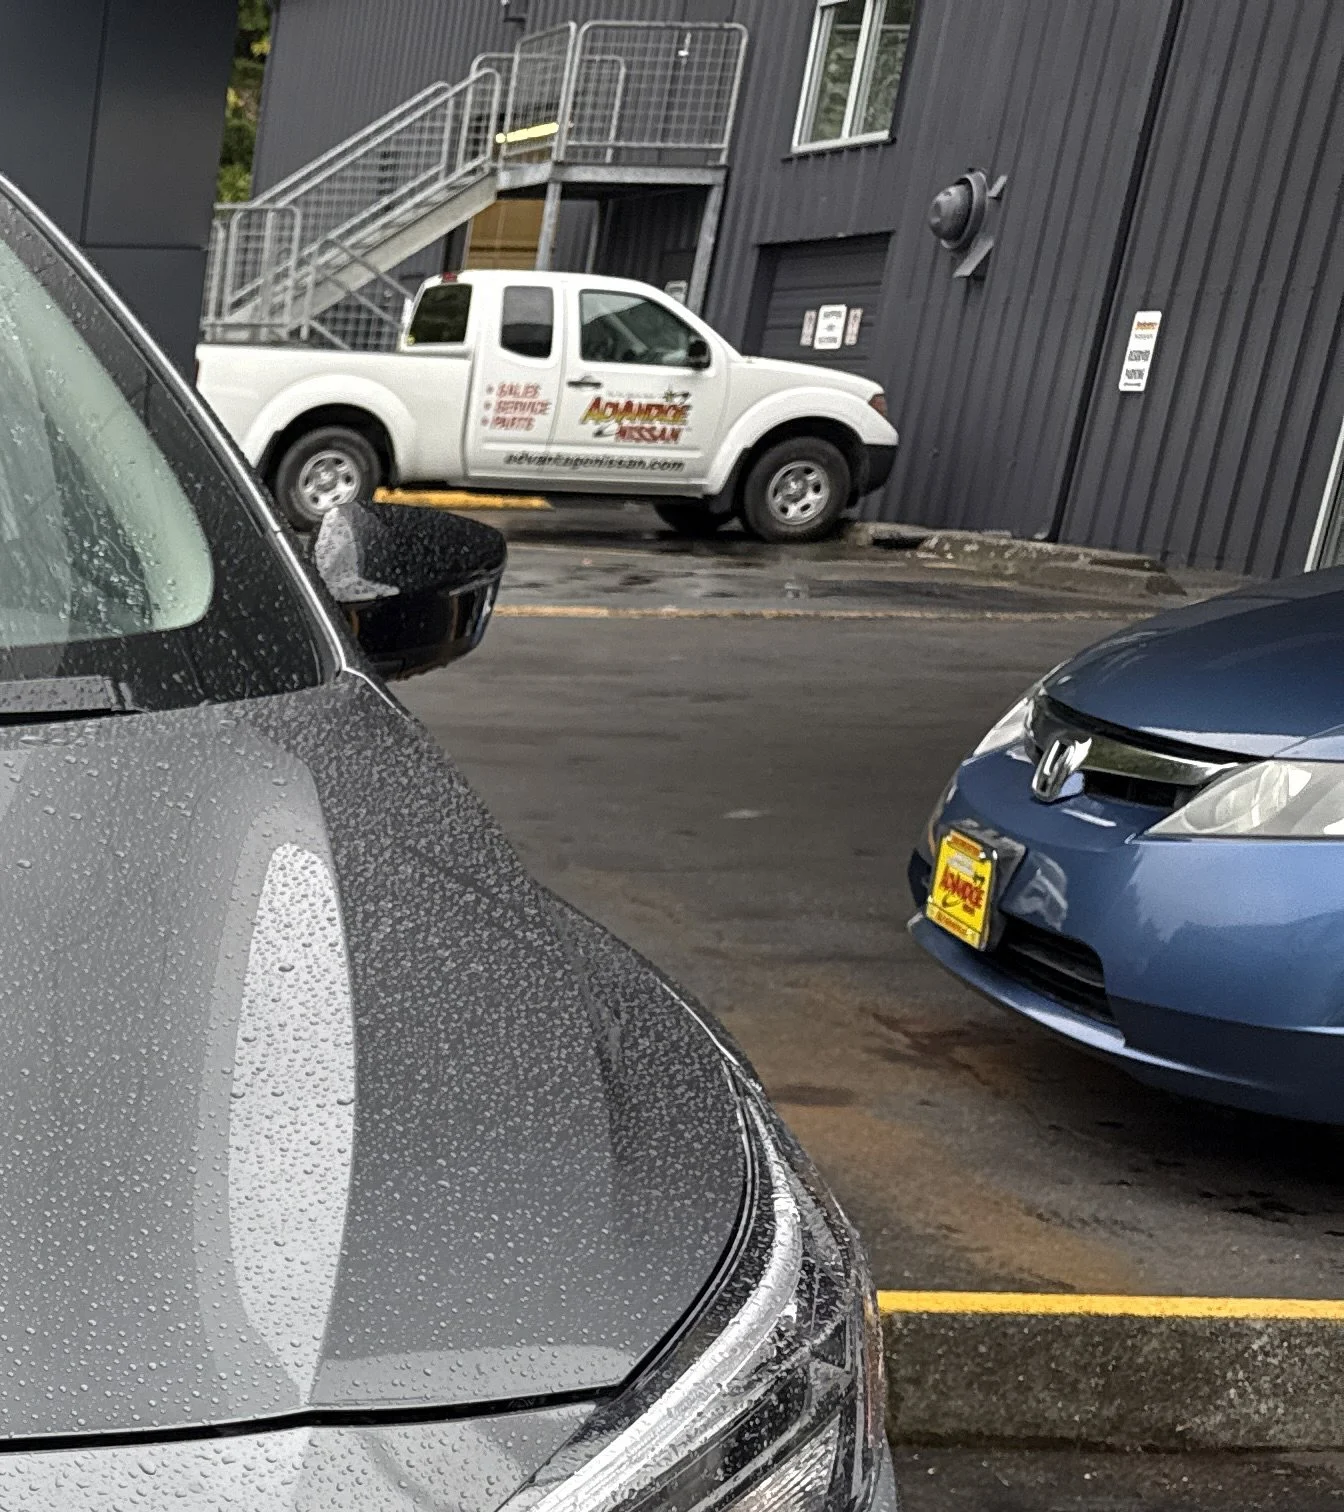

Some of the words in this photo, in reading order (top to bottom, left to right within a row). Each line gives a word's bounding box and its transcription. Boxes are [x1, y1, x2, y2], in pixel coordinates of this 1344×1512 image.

[495, 383, 541, 399] SALES
[579, 396, 692, 425] ADVANTAGE
[614, 424, 686, 444] NISSAN
